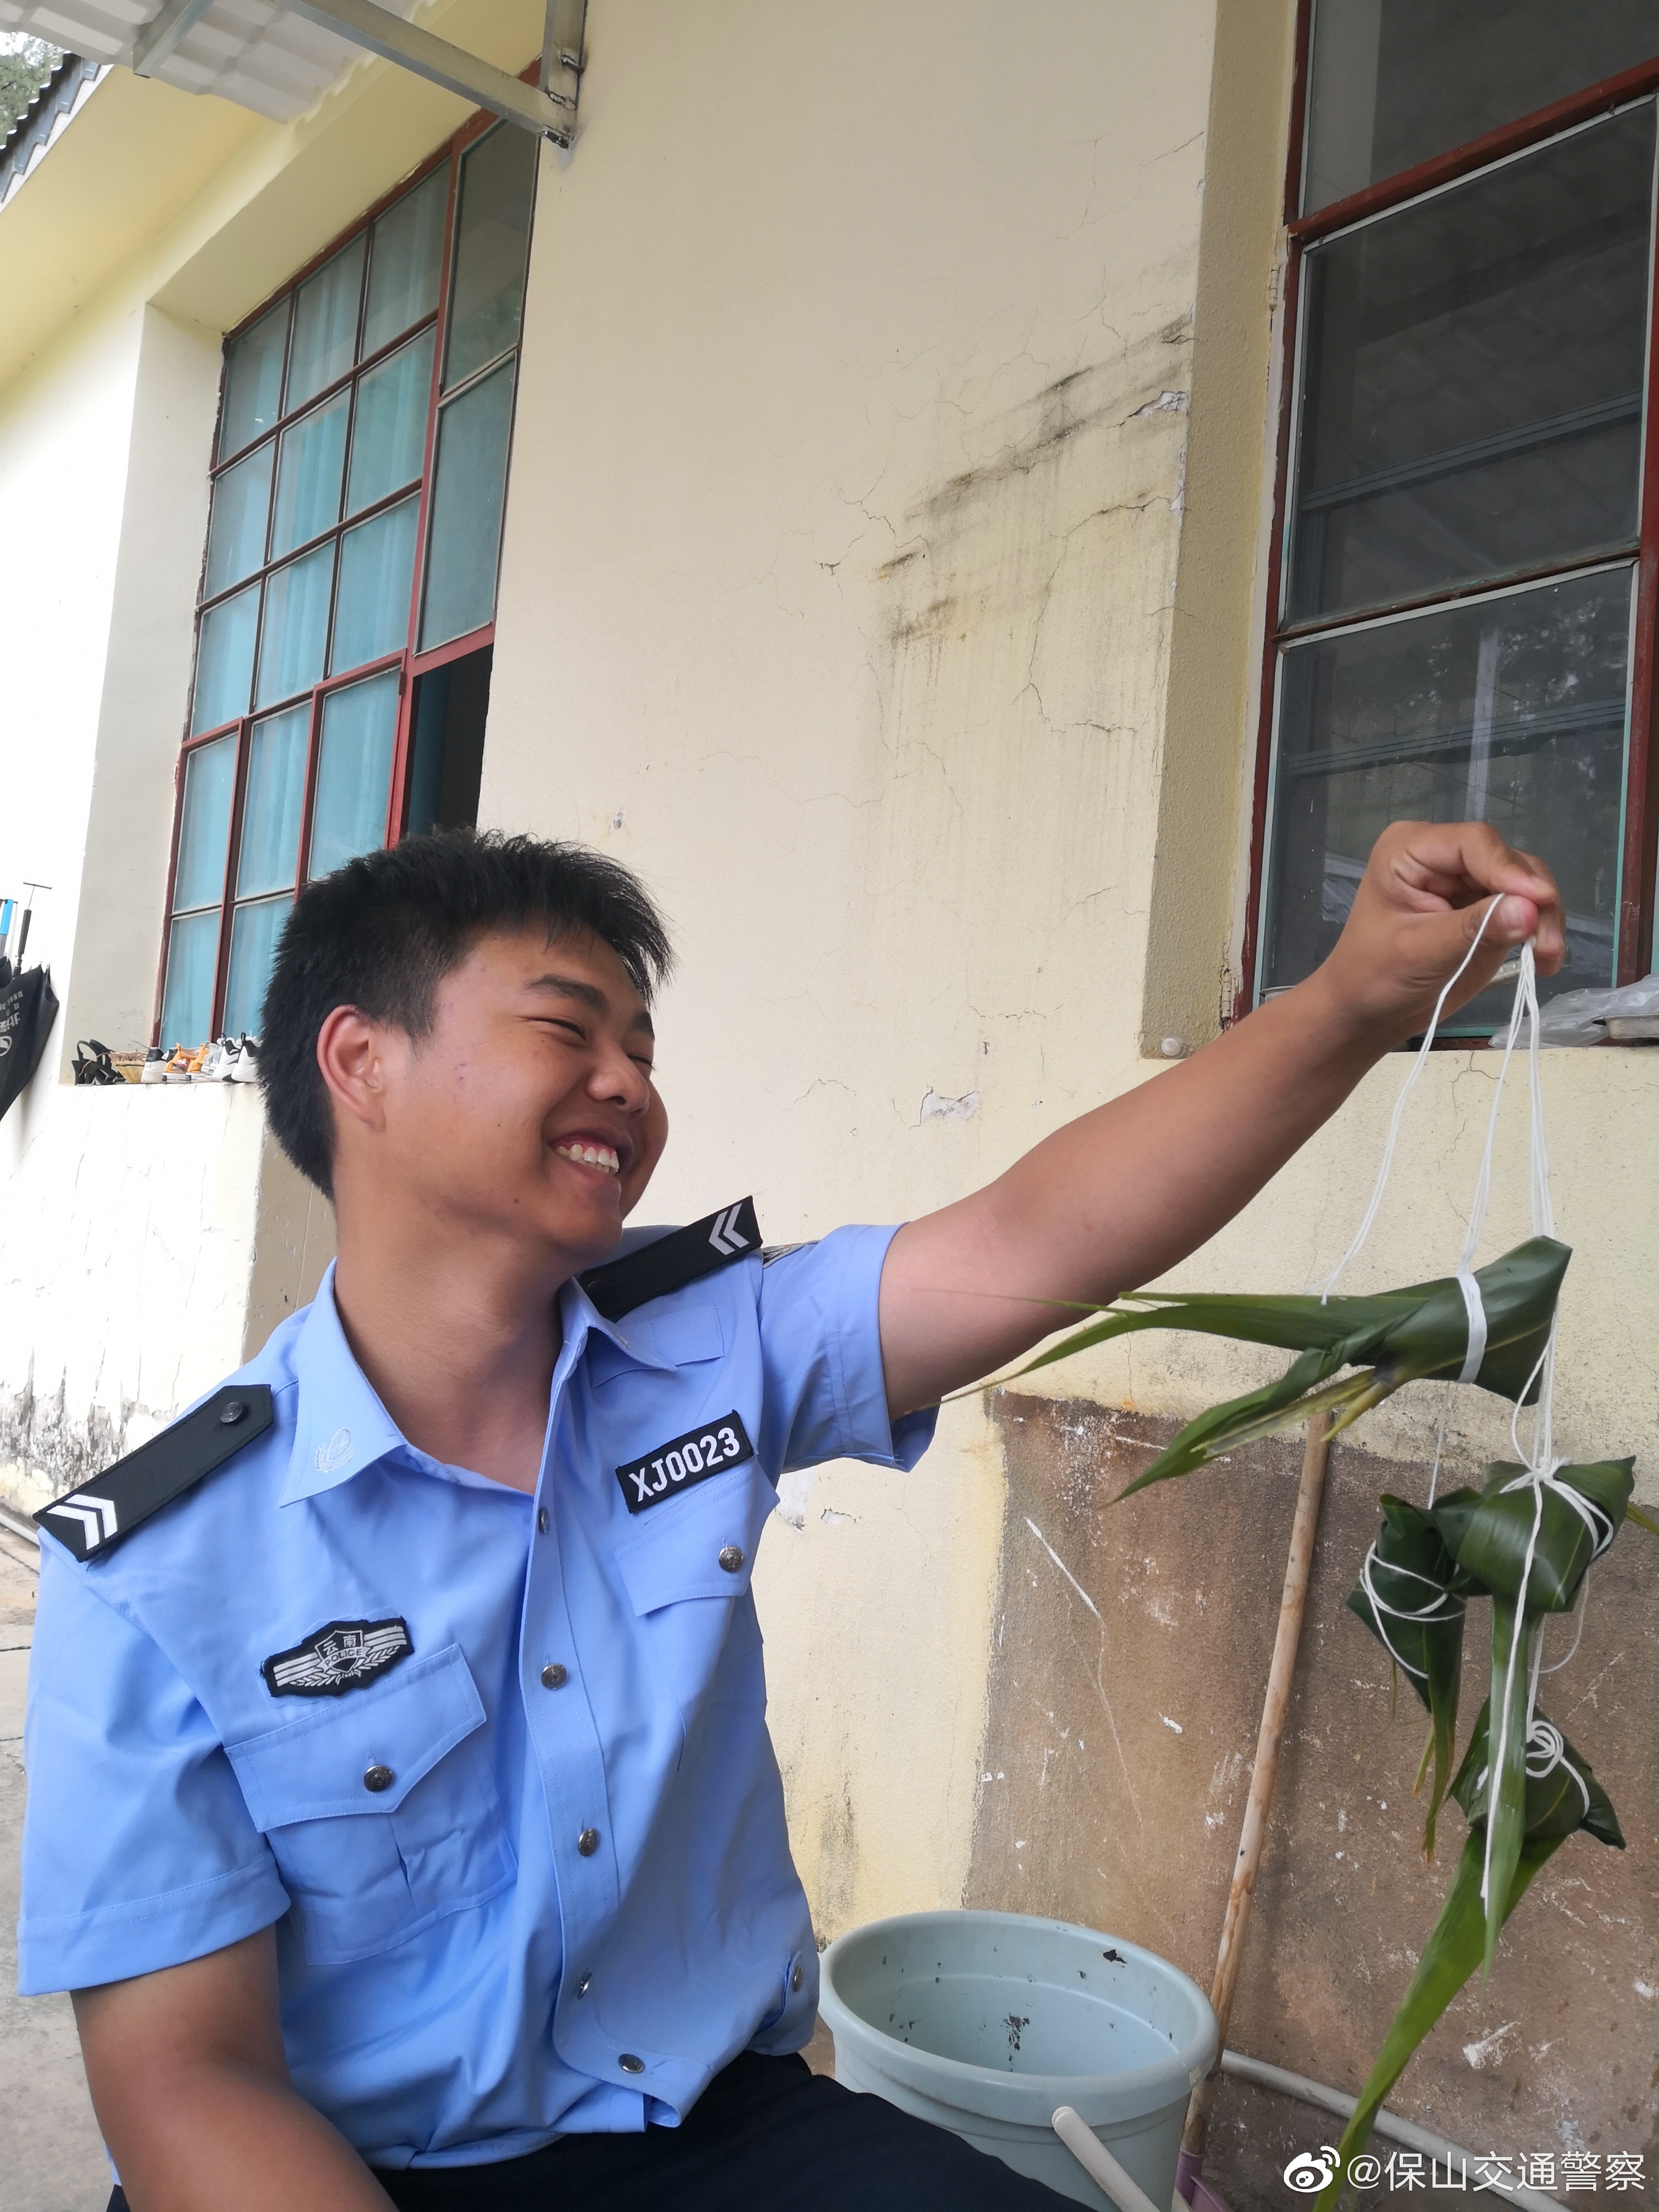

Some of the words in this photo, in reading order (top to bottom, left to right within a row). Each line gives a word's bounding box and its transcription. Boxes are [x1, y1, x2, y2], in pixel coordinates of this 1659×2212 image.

[629, 1427, 740, 1502] XJ0023
[323, 1634, 356, 1656] 云南
[324, 1649, 363, 1667] POLICE
